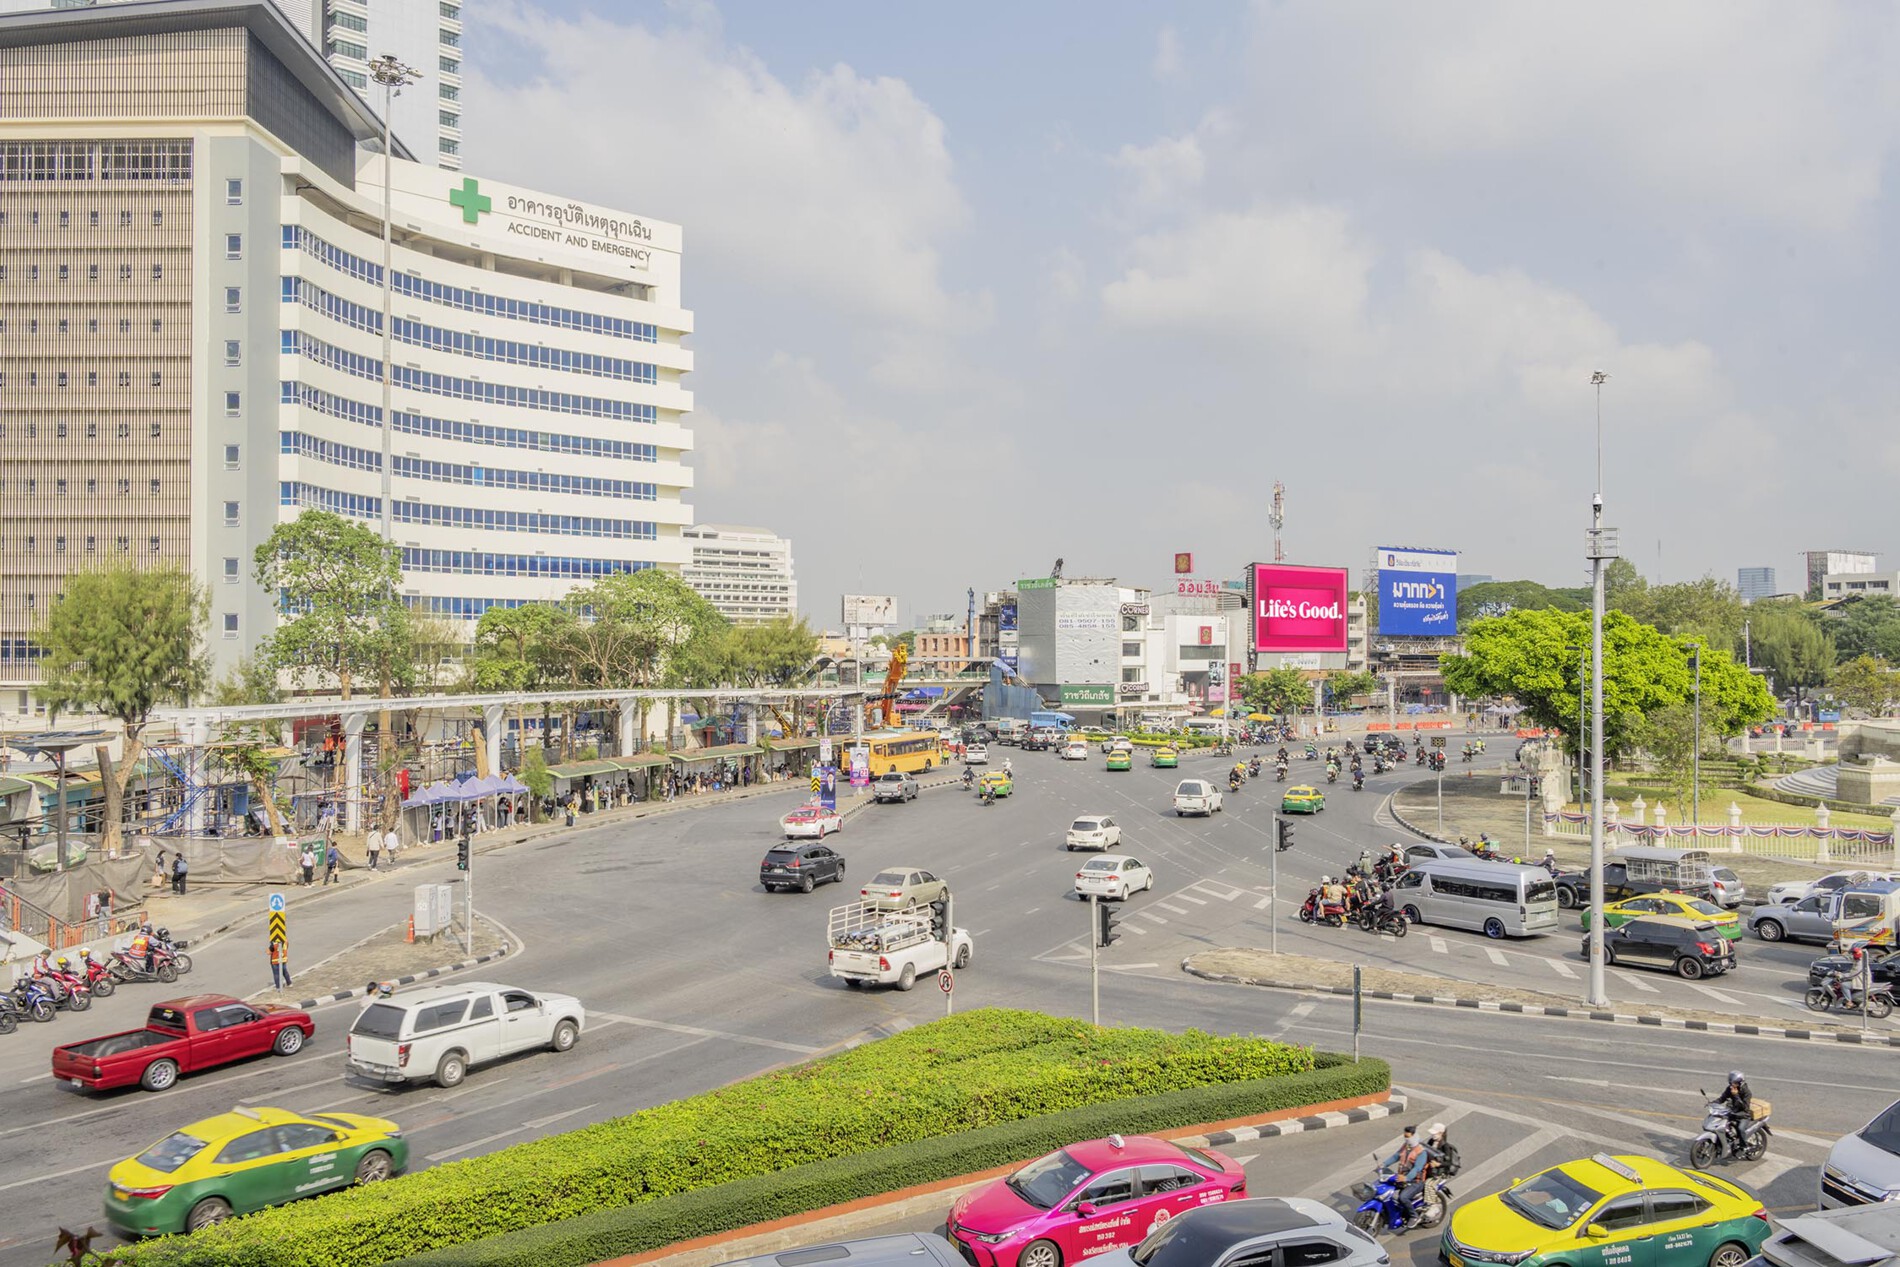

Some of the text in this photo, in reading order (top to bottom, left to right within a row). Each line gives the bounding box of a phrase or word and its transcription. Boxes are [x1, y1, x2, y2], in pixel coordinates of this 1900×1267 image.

[507, 194, 652, 241] อาคารอุบัติเหตุฉุกเฉิน
[507, 222, 652, 262] ACCIDENT AND EMERGENCY
[1392, 578, 1445, 600] มากกว่า
[1121, 603, 1150, 615] CORNER
[1259, 599, 1343, 619] Life's Good.
[1063, 689, 1110, 701] ราชวิถีเภสัช
